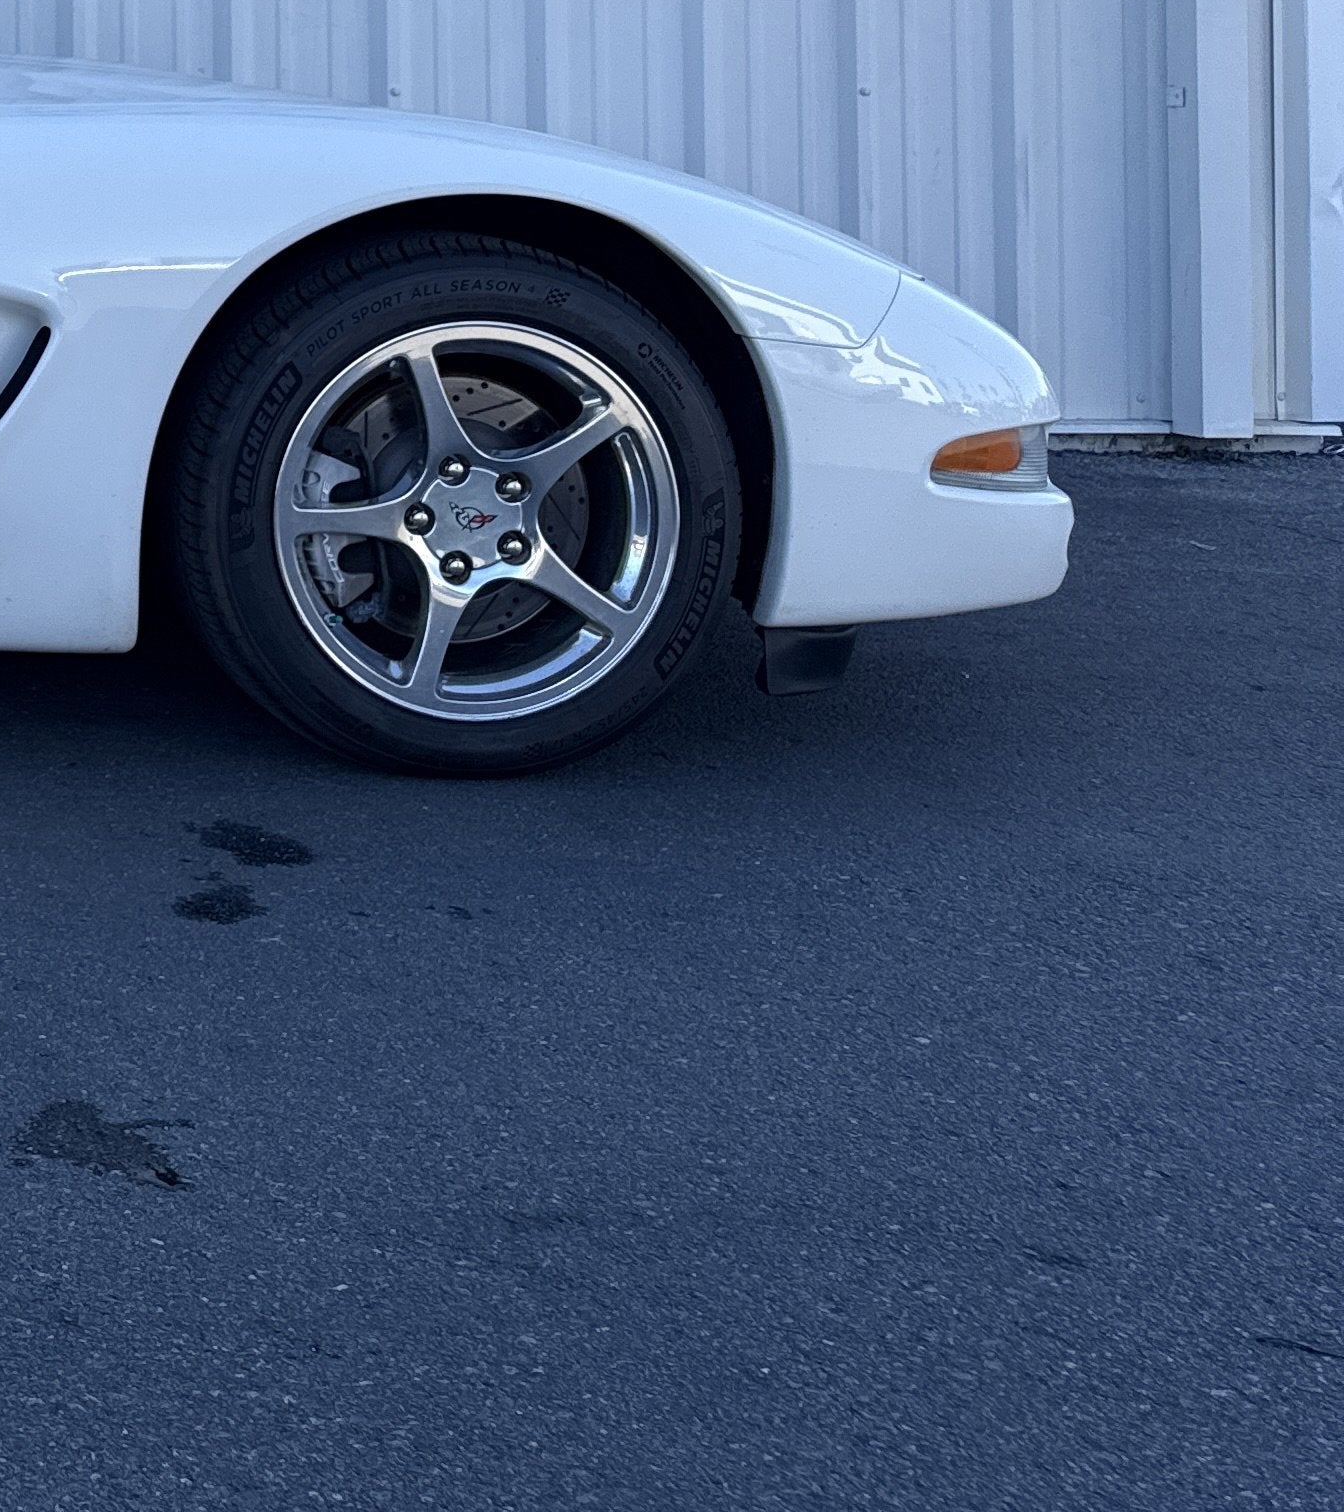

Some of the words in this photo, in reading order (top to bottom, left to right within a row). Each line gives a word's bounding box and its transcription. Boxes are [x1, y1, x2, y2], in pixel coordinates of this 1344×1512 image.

[306, 321, 347, 357] PILOT
[351, 292, 403, 325] SPORT
[408, 282, 442, 300] ALL
[450, 279, 521, 294] SEASON
[232, 367, 300, 503] MICHELIN
[658, 539, 720, 670] MICHELIN
